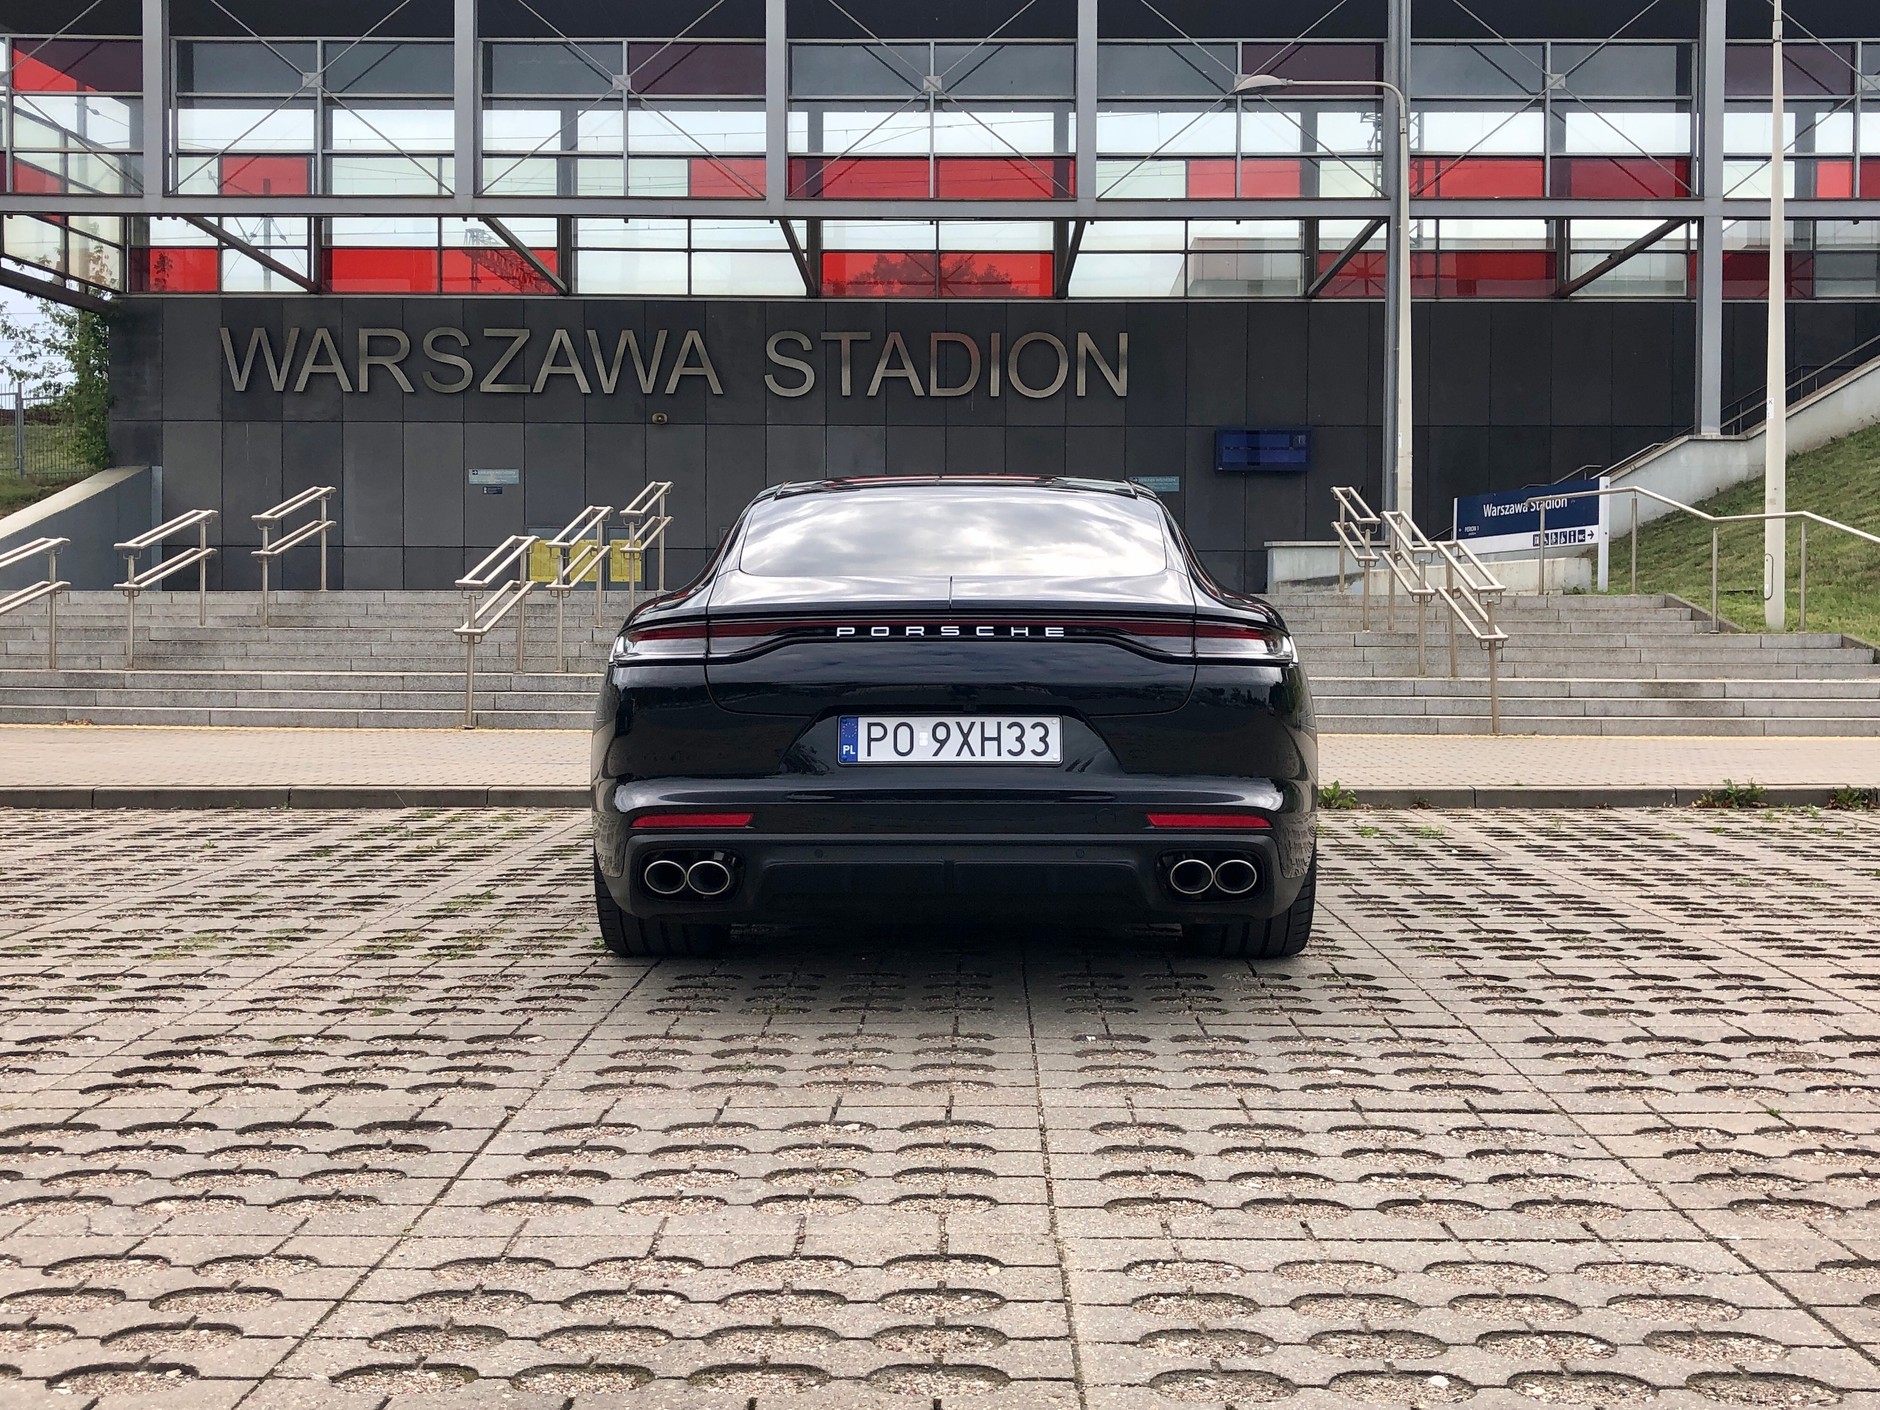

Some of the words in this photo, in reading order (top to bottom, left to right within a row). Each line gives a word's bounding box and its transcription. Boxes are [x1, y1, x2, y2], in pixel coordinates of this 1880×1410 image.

[219, 327, 724, 395] WARSZAWA
[764, 330, 1129, 398] STADION
[1483, 502, 1528, 518] Warszawa
[836, 626, 1065, 637] PORSCHE
[931, 721, 1050, 757] 9XH33
[842, 745, 856, 755] PL
